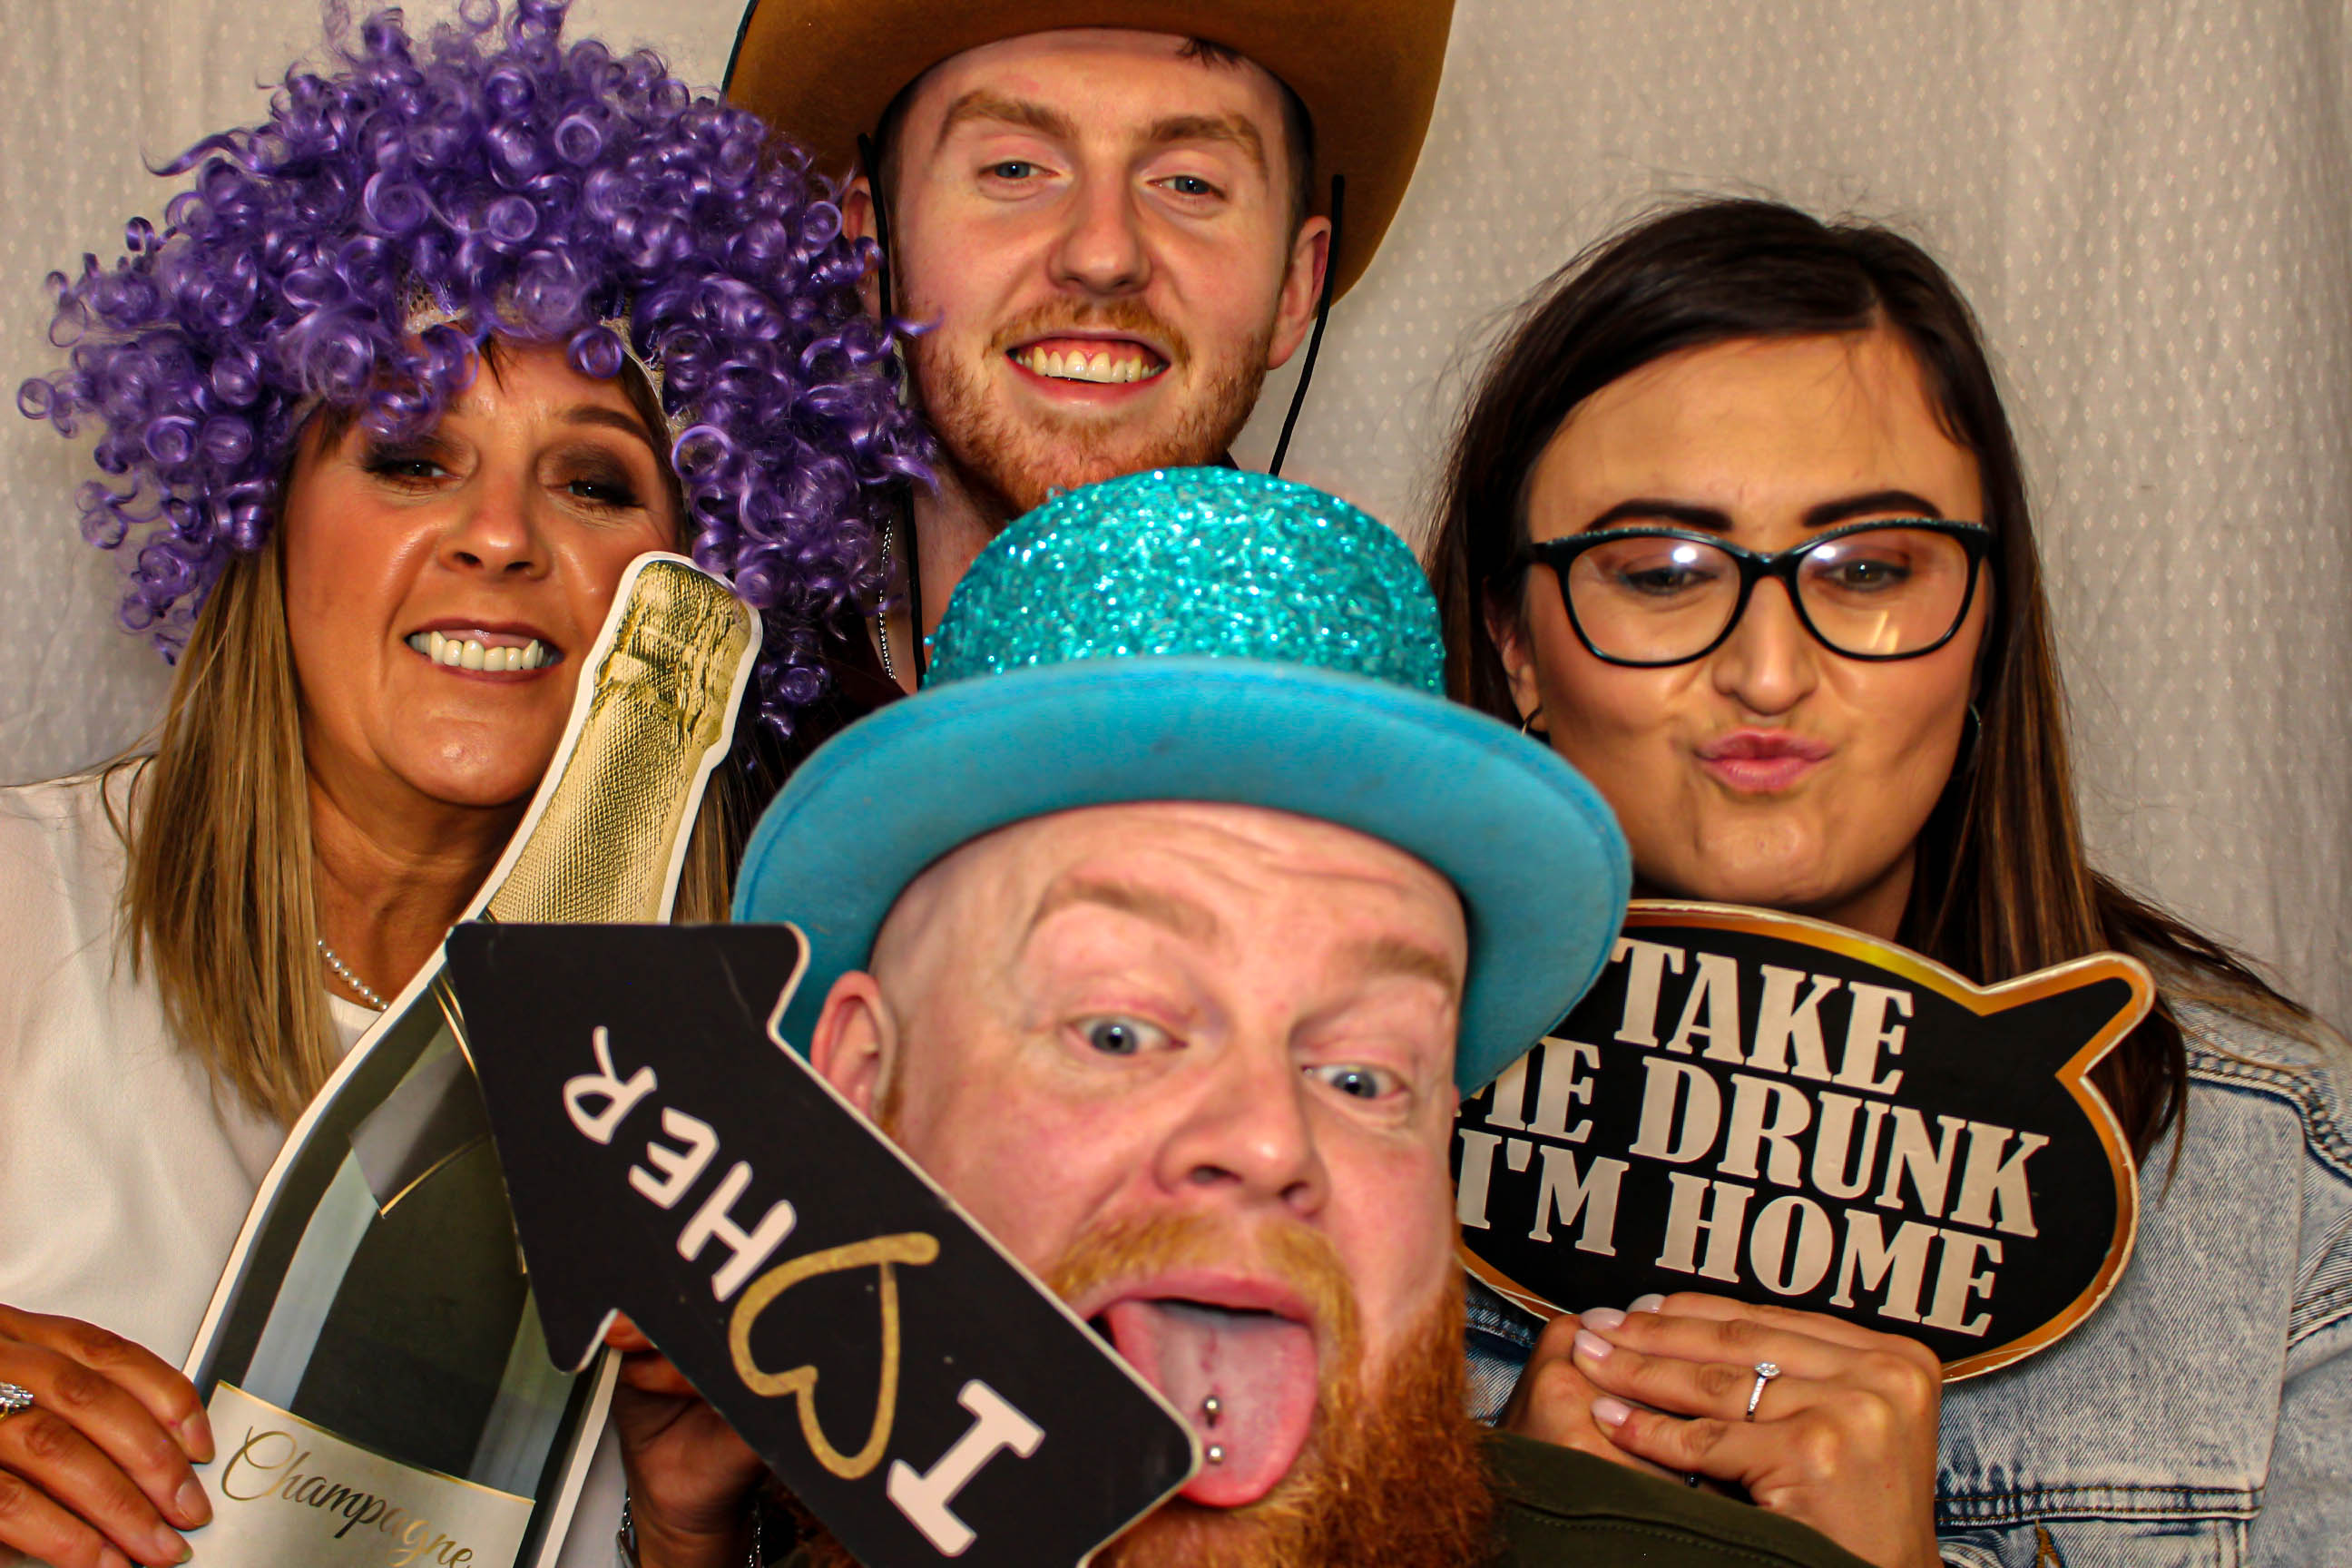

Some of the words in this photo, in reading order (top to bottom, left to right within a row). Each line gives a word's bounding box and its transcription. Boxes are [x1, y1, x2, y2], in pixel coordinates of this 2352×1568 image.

[1612, 937, 1913, 1094] TAKE
[563, 1025, 797, 1302] HER
[1458, 1128, 1630, 1257] I'M
[1655, 1171, 2003, 1337] HOME
[1629, 1055, 2049, 1238] DRUNK
[221, 1426, 474, 1568] Champagne
[887, 1379, 1045, 1556] I
